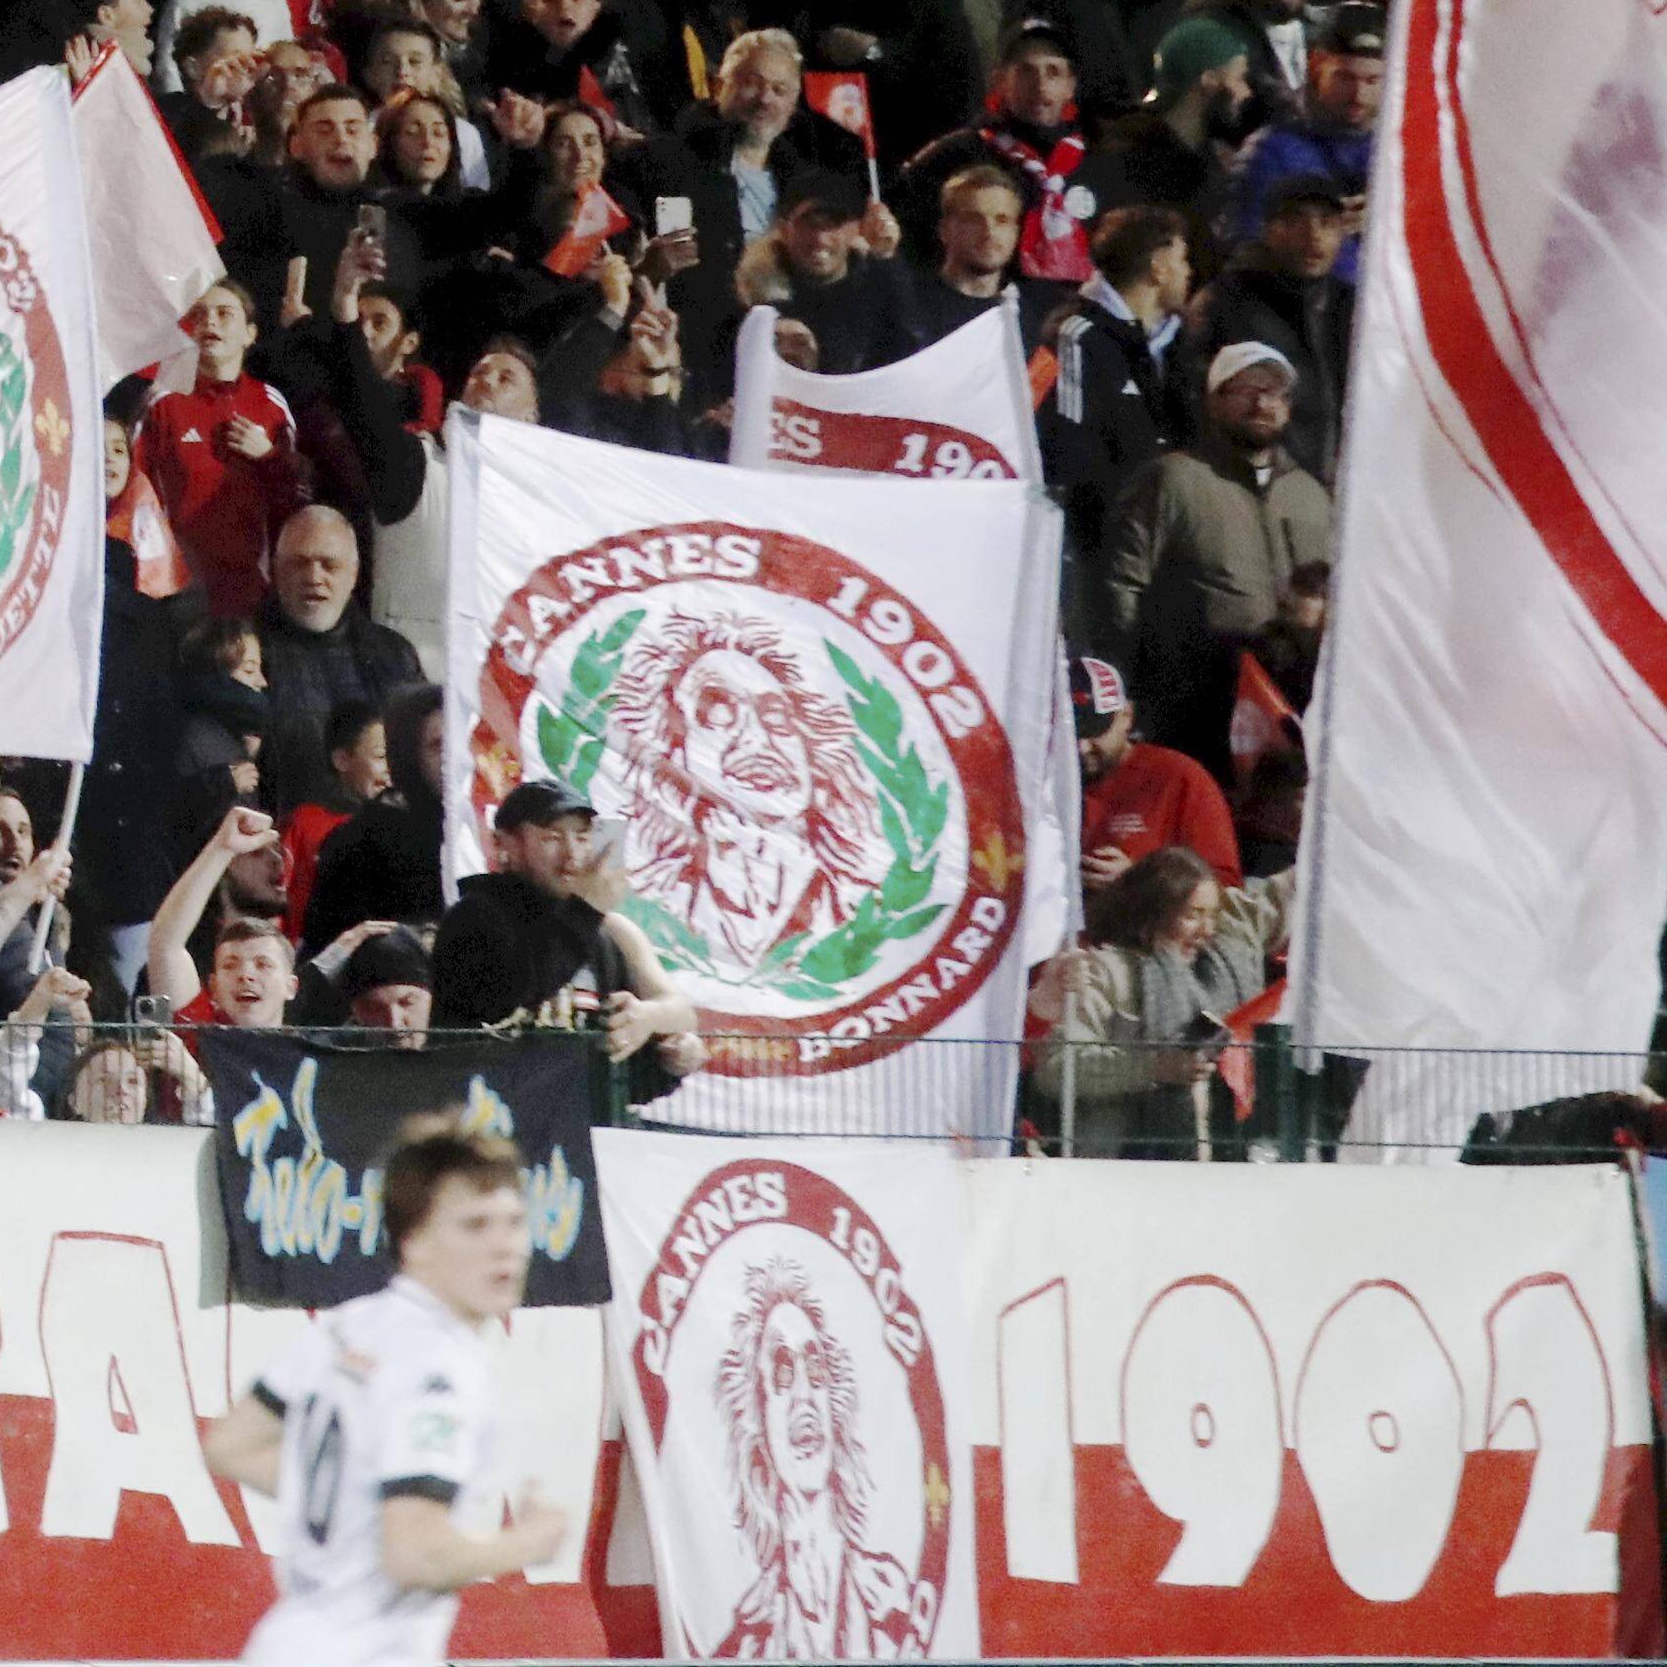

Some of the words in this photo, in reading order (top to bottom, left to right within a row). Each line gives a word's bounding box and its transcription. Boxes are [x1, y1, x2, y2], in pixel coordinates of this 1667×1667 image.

[501, 532, 762, 677] CANNES
[826, 574, 985, 740] 1902
[797, 896, 1007, 1063] BONNARD
[641, 1171, 790, 1377] CANNES
[829, 1206, 923, 1366] 1902
[996, 1271, 1620, 1604] 1902
